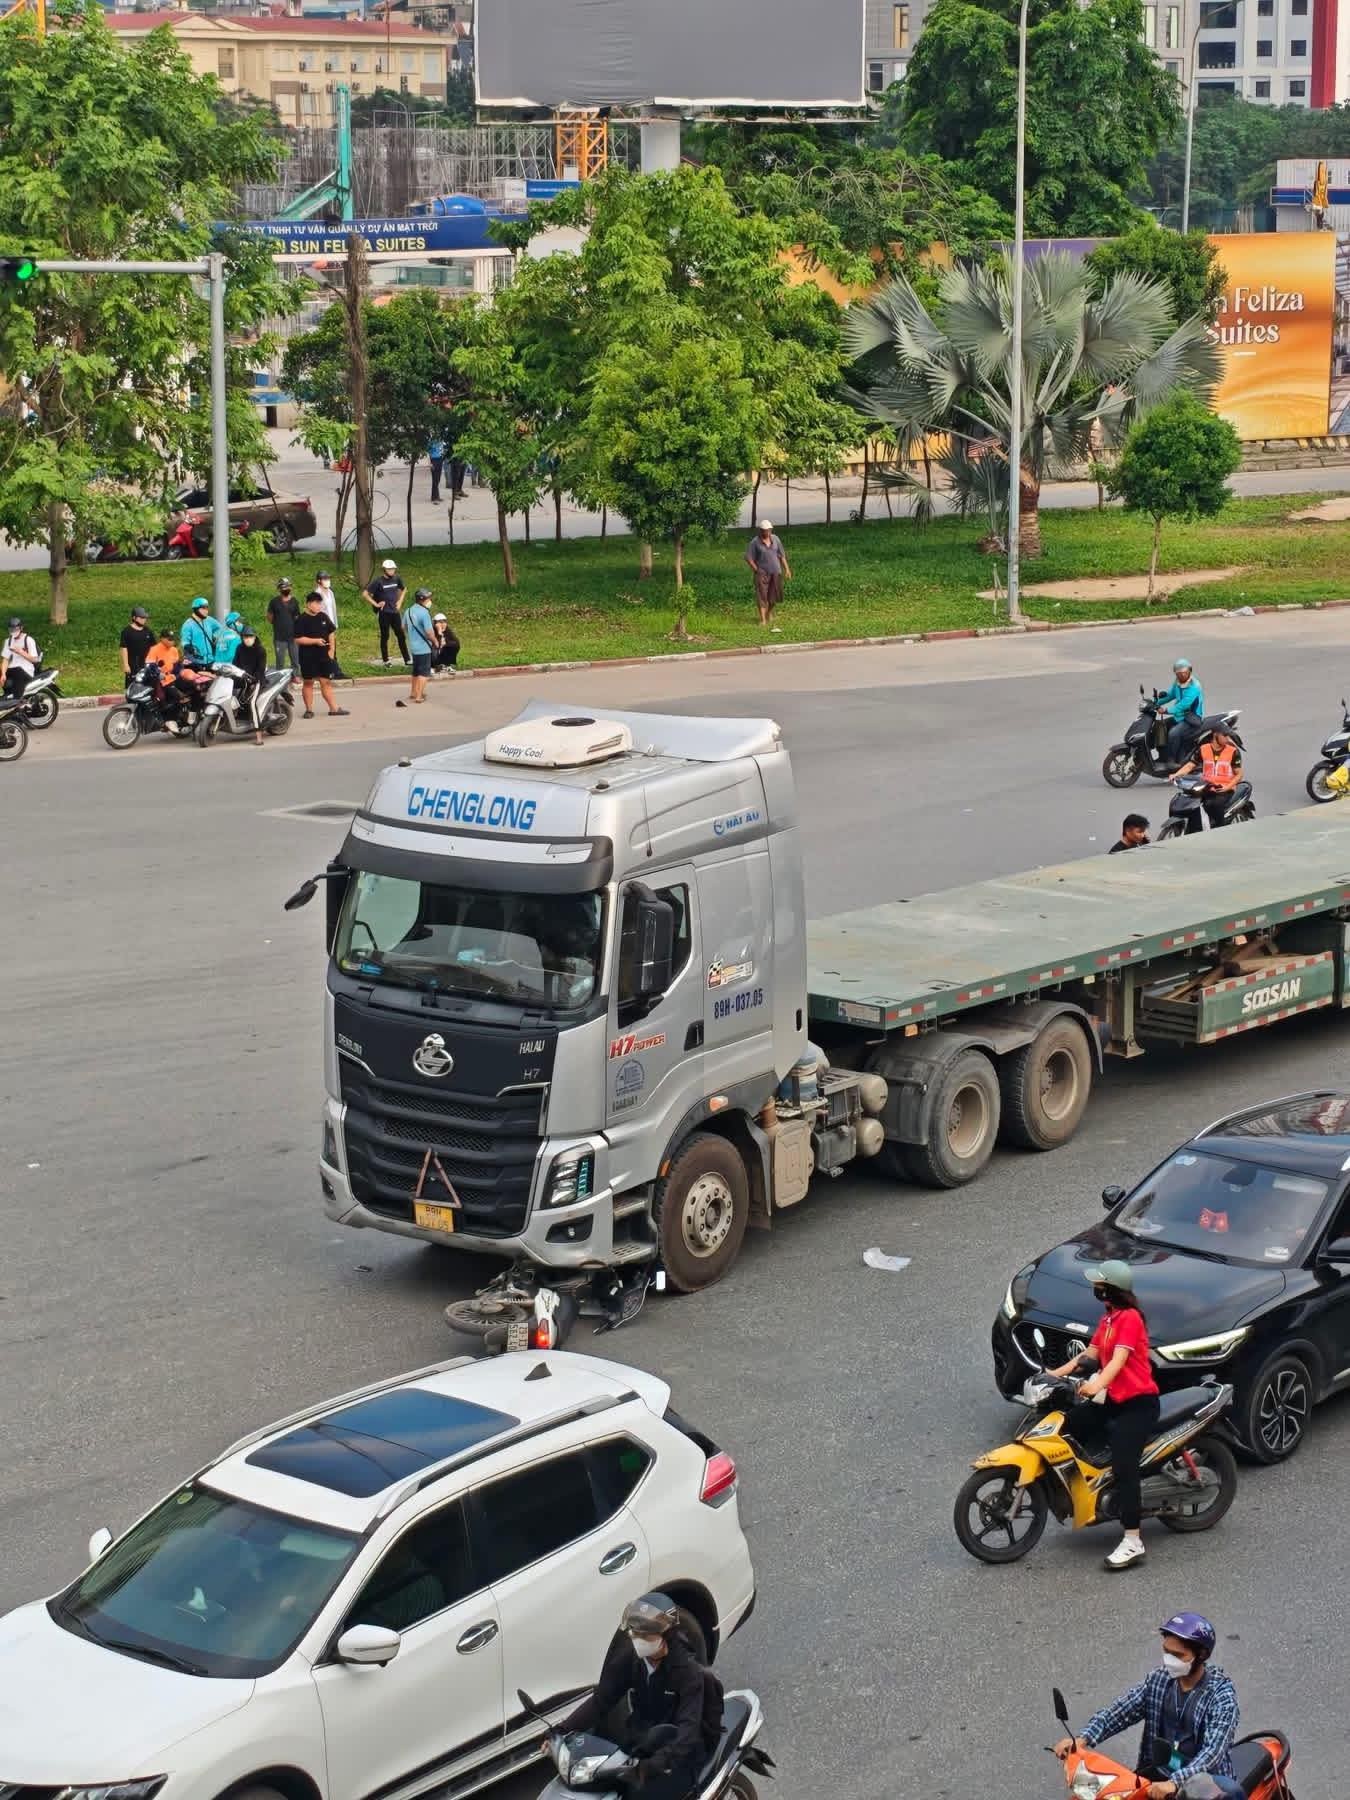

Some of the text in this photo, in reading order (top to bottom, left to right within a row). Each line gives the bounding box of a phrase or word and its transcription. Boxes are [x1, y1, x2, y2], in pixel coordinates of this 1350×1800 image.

[268, 226, 291, 235] TNHH
[290, 239, 319, 253] SUN
[324, 238, 372, 253] FELA
[376, 237, 426, 251] SUITES
[1235, 286, 1304, 313] Feliza
[1203, 317, 1280, 345] Suites
[499, 744, 544, 758] Happy Cool
[408, 787, 536, 830] CHENGLONG
[1241, 977, 1301, 1014] SOOSAN
[523, 1068, 541, 1081] H7
